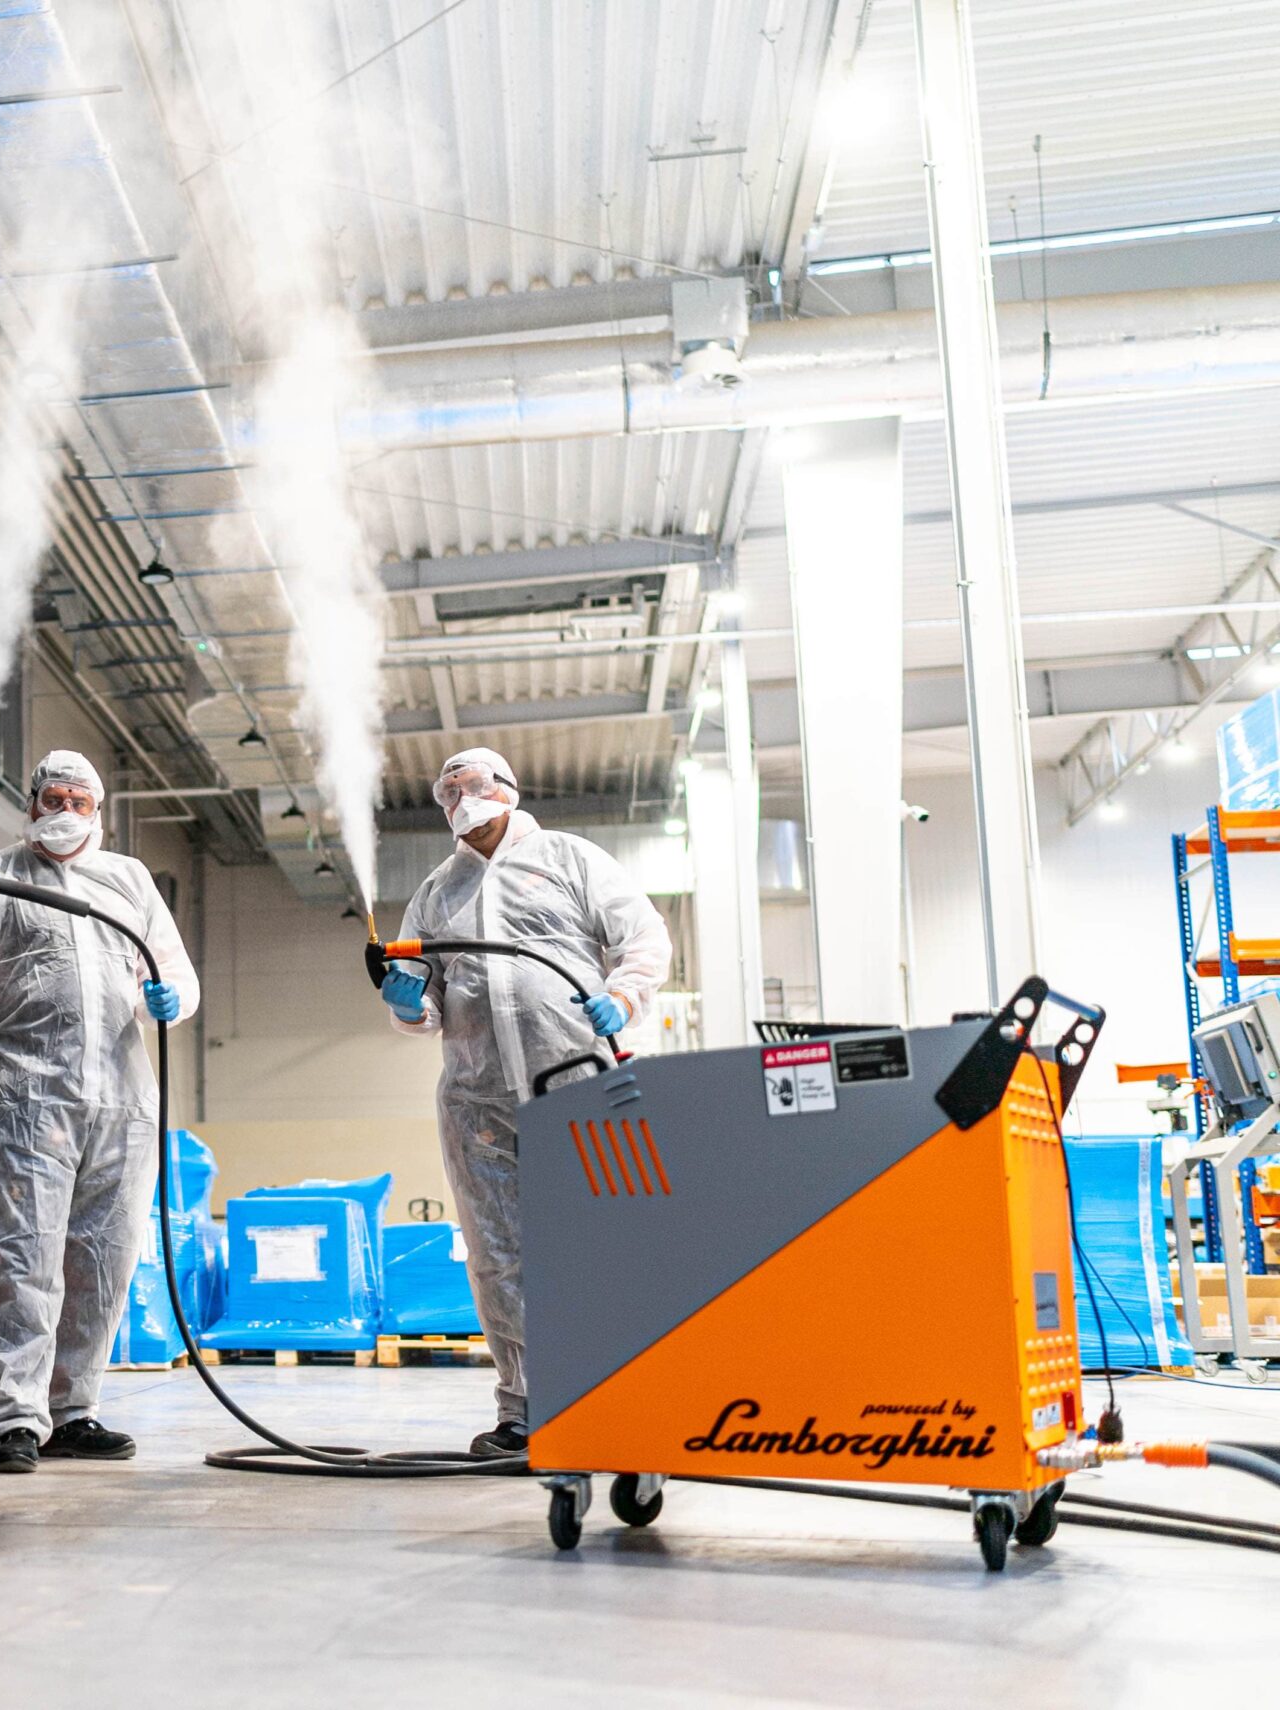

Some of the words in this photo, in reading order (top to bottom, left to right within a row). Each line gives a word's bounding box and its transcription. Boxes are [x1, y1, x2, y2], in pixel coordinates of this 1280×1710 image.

[776, 1046, 829, 1063] DANGER
[860, 1399, 947, 1419] powered
[952, 1400, 977, 1421] by
[683, 1398, 998, 1470] Lamborghini
